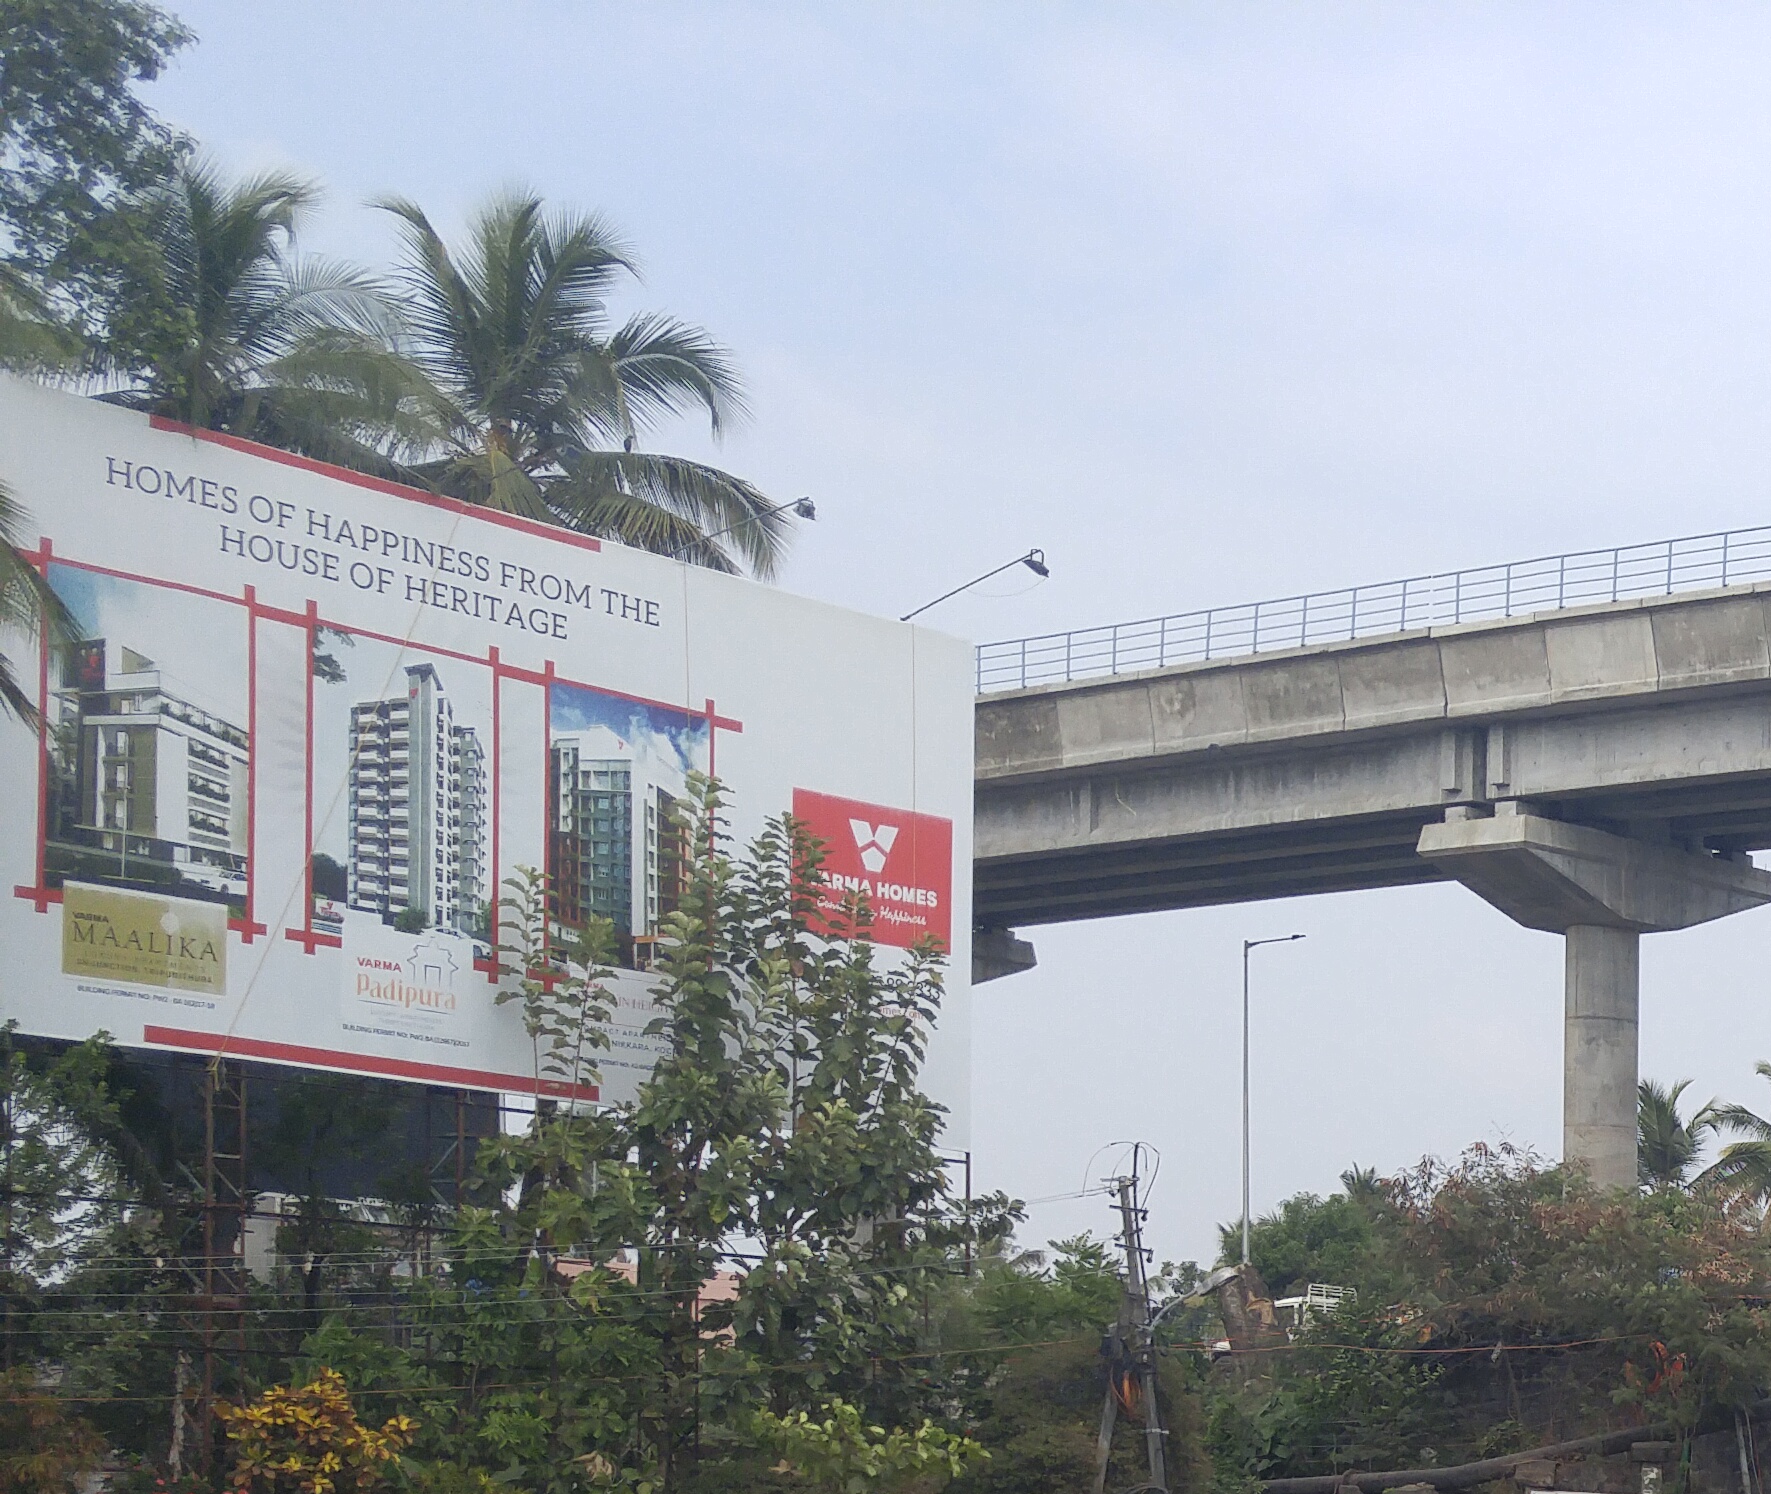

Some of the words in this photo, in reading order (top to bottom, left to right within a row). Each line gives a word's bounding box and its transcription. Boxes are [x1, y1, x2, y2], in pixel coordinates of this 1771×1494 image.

[106, 456, 238, 514] HOMES
[249, 495, 296, 528] OF
[306, 508, 490, 582] HAPPINESS
[500, 561, 591, 609] FROM
[600, 588, 661, 627] THE
[219, 524, 339, 581] HOUSE
[350, 562, 394, 593] OF
[404, 574, 568, 640] HERITAGE
[877, 881, 937, 907] HOMES
[72, 921, 218, 962] MAALIKA
[357, 957, 402, 972] VARMA
[357, 973, 456, 1010] Padipura
